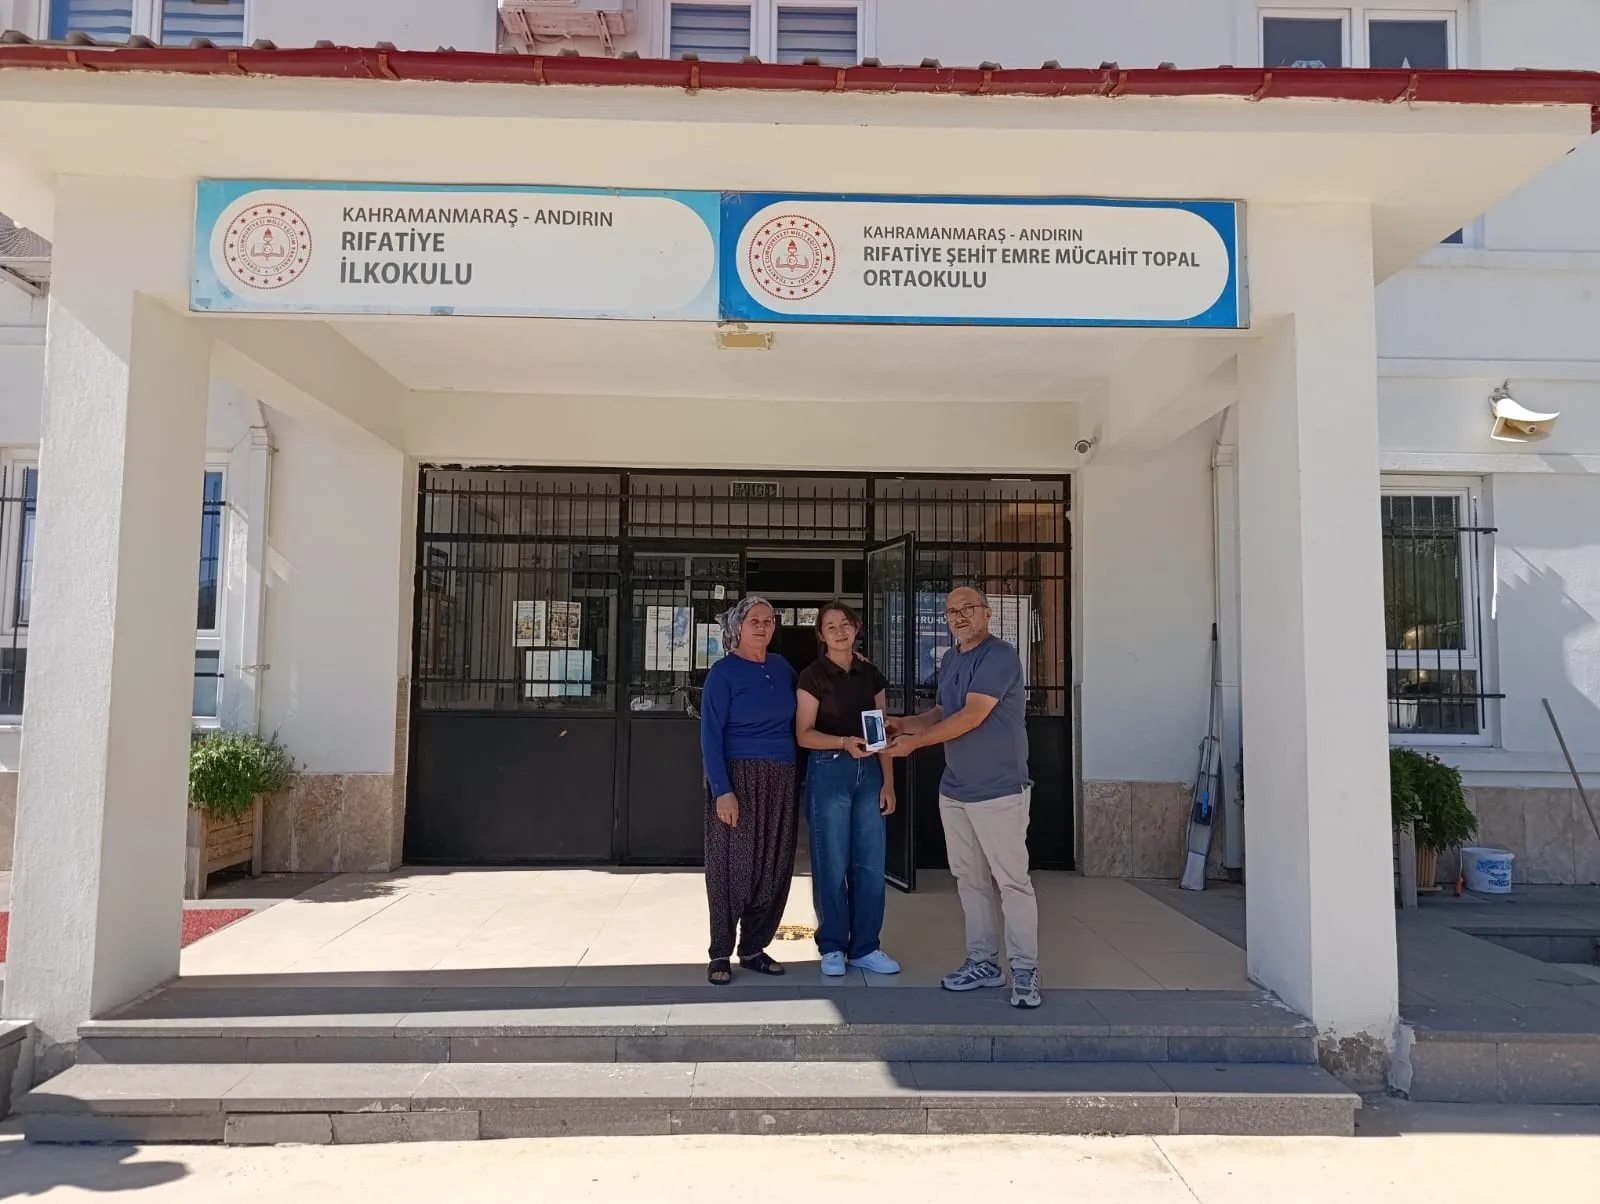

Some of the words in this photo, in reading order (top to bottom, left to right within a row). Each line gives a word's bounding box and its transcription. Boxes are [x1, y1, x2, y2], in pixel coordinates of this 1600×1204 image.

[343, 207, 518, 227] KAHRAMANMARAŞ
[534, 209, 613, 226] ANDIRIN
[341, 228, 445, 252] RIFATİYE
[863, 225, 1006, 244] KAHRAMANMARAŞ
[1019, 228, 1083, 242] ANDIRIN
[863, 243, 942, 263] RIFATİYE
[946, 245, 997, 266] ŞEHİT
[1001, 248, 1050, 264] EMRE
[1055, 245, 1138, 266] MÜCAHİT
[1142, 251, 1200, 267] TOPAL
[340, 256, 472, 285] İLKOKULU
[863, 269, 987, 288] ORTAOKULU
